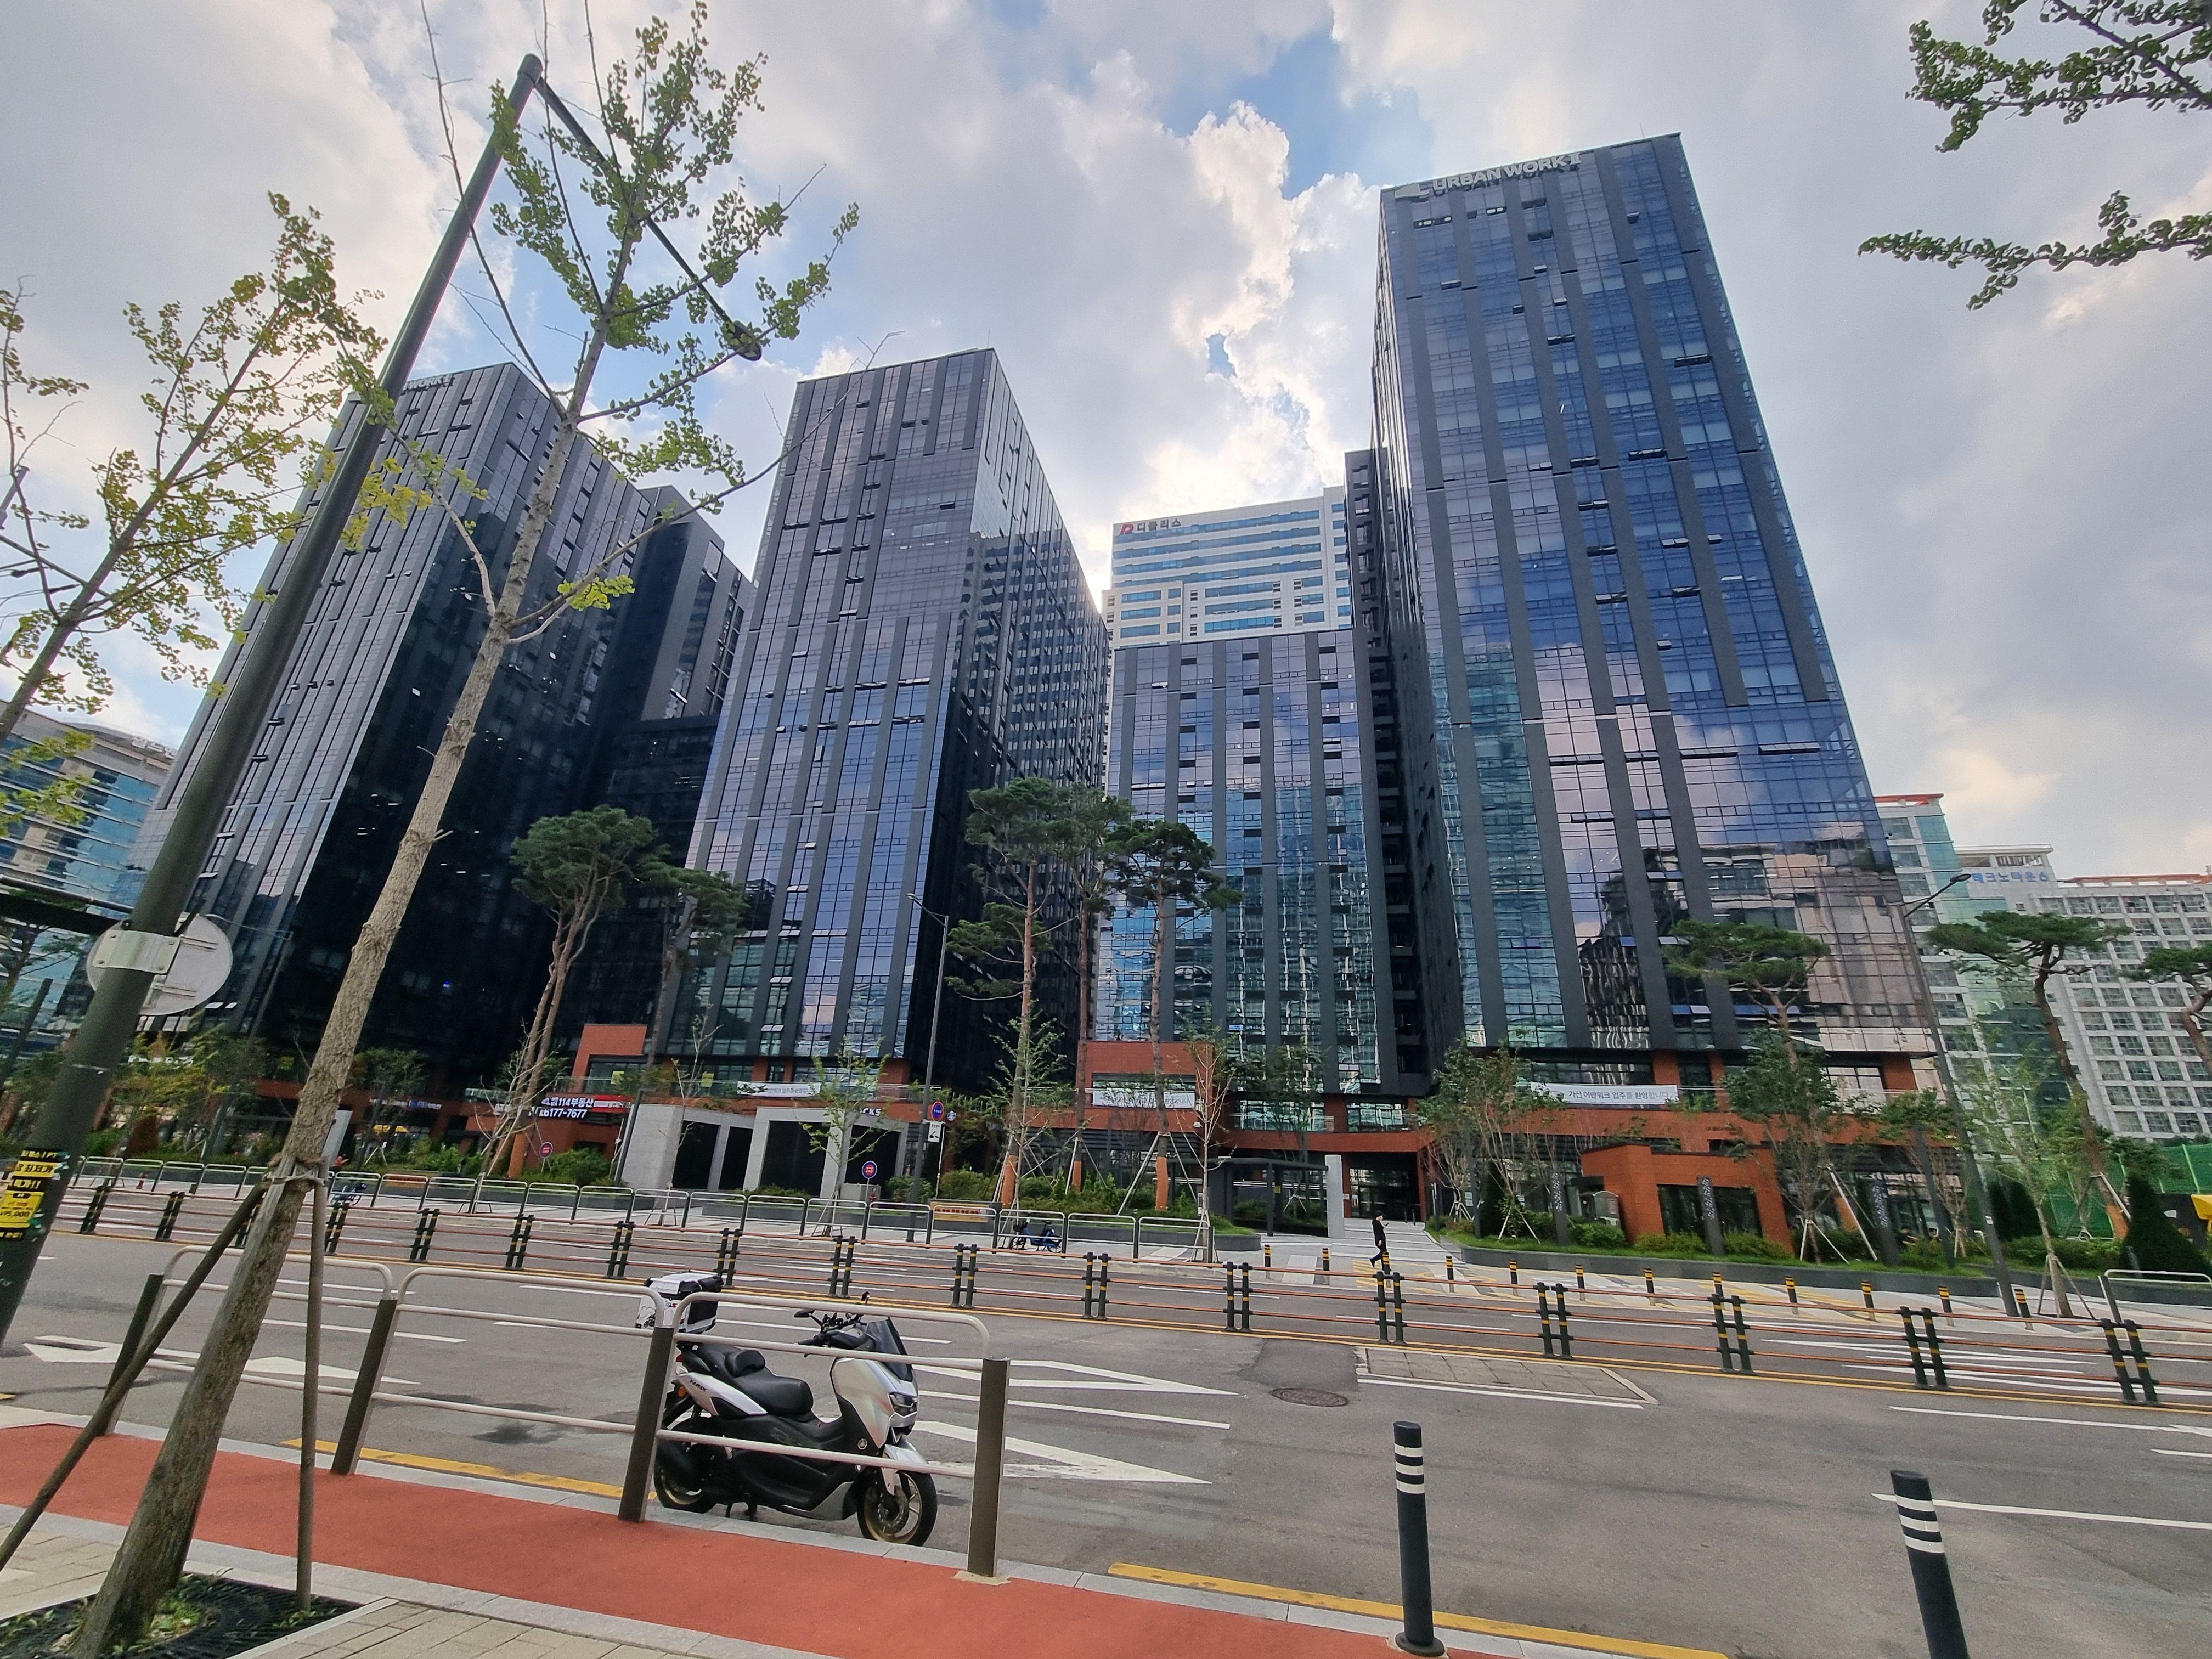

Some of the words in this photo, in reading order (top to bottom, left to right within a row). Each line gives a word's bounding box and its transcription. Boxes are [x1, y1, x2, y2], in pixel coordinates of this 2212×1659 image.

[1432, 167, 1502, 190] URBAN
[1503, 155, 1566, 178] WORK
[1583, 1091, 1610, 1099] 어반워크
